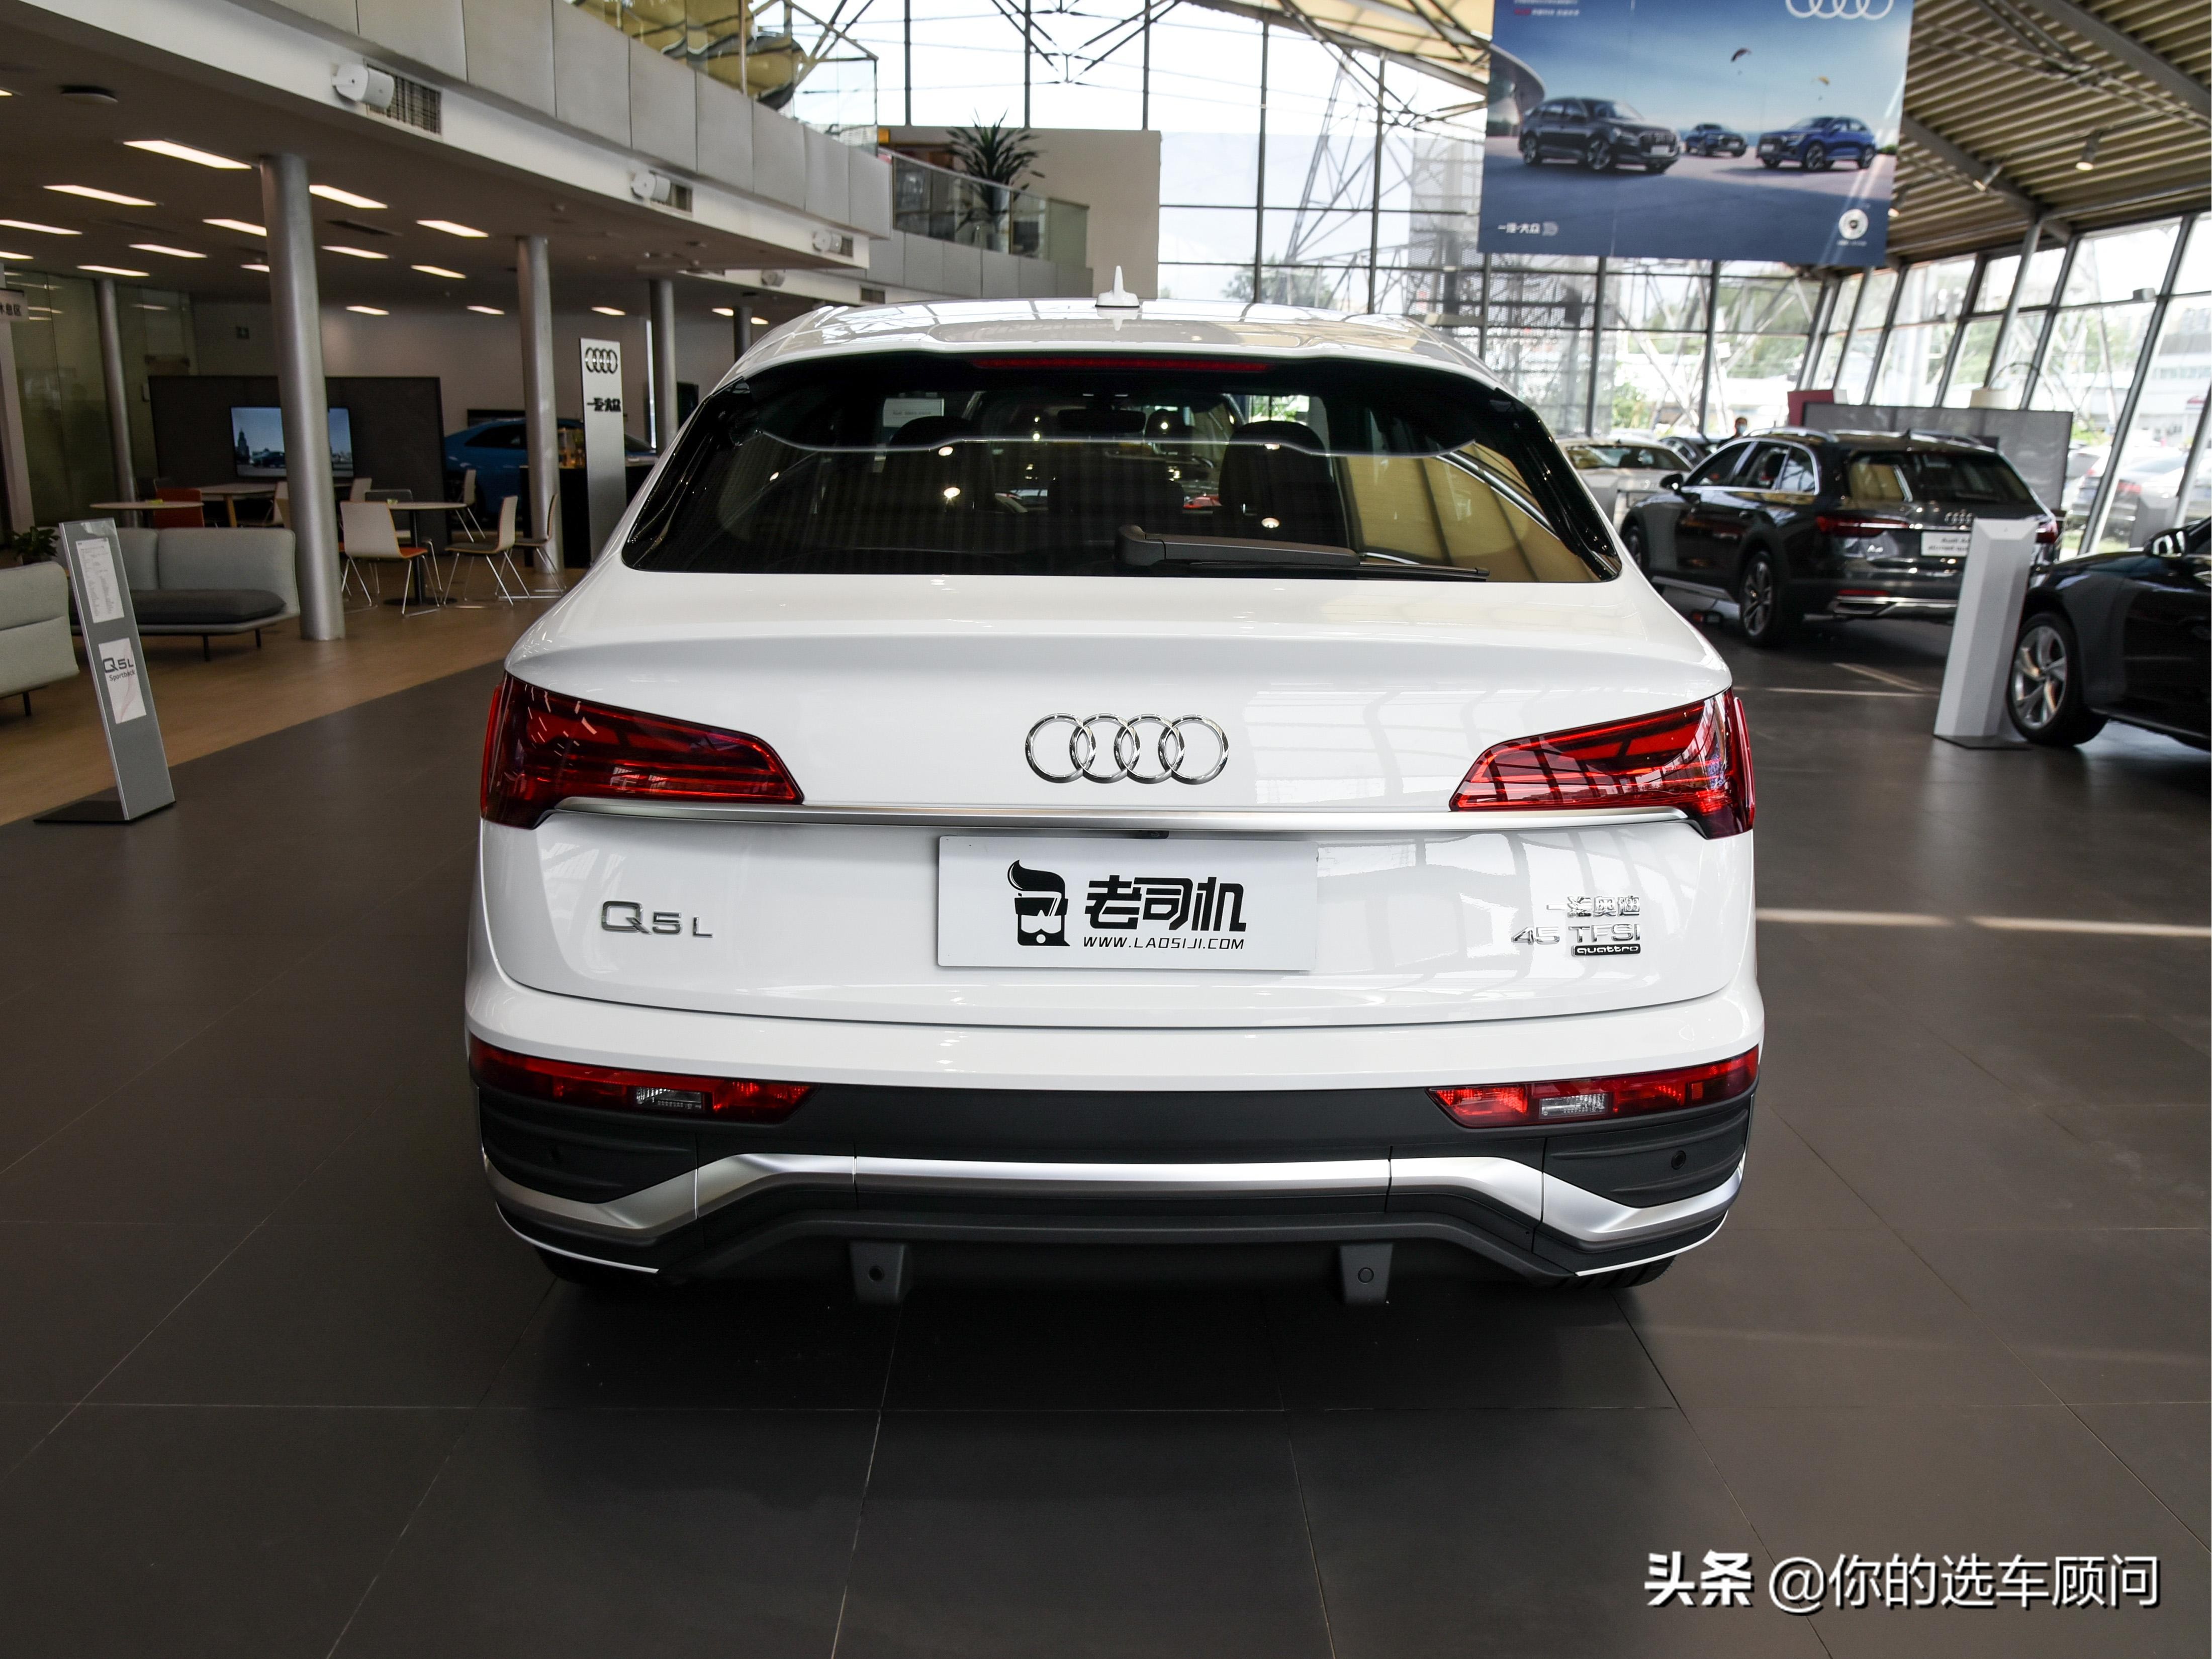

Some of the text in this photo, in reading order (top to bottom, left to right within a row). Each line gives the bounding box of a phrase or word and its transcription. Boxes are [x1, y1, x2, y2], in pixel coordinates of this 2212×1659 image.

[103, 657, 134, 674] Q5L
[109, 669, 136, 682] Sportback
[1084, 874, 1247, 932] 老司机
[1511, 924, 1641, 945] 45 TFSI
[1083, 936, 1245, 950] WWW.LAOSIJI.COM
[1576, 945, 1639, 955] quattro
